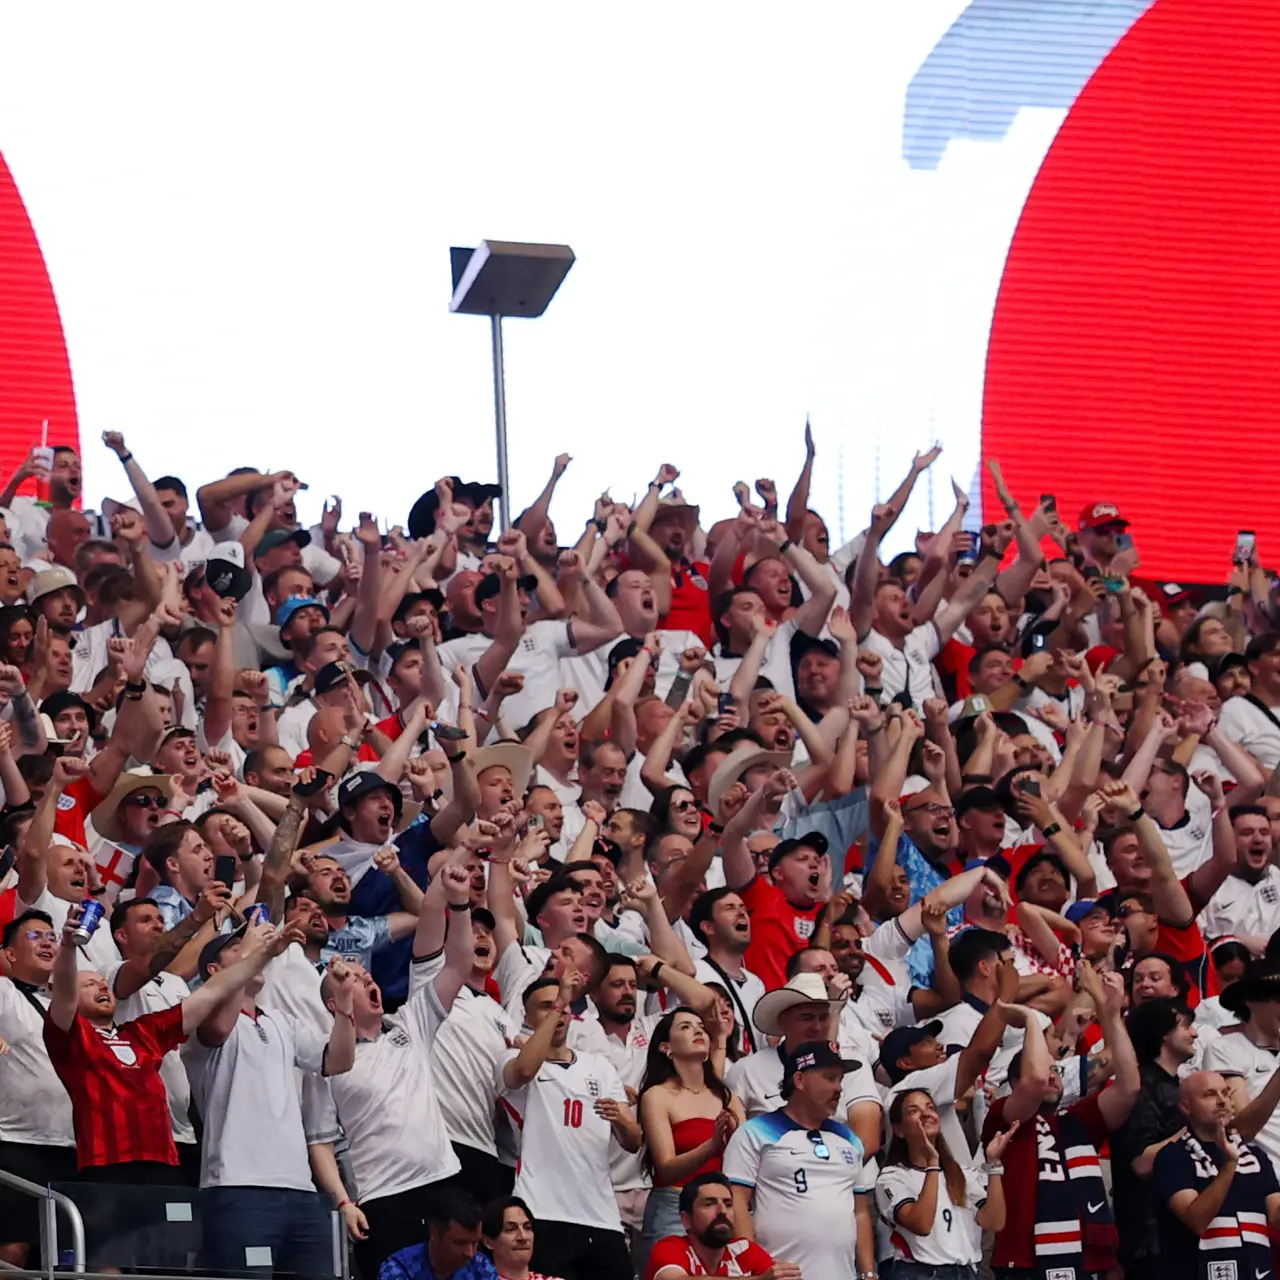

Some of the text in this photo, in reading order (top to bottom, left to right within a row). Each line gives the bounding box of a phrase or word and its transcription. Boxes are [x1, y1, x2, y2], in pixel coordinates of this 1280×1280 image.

[564, 1098, 583, 1128] 10
[794, 1168, 808, 1193] 9
[943, 1209, 952, 1232] 9
